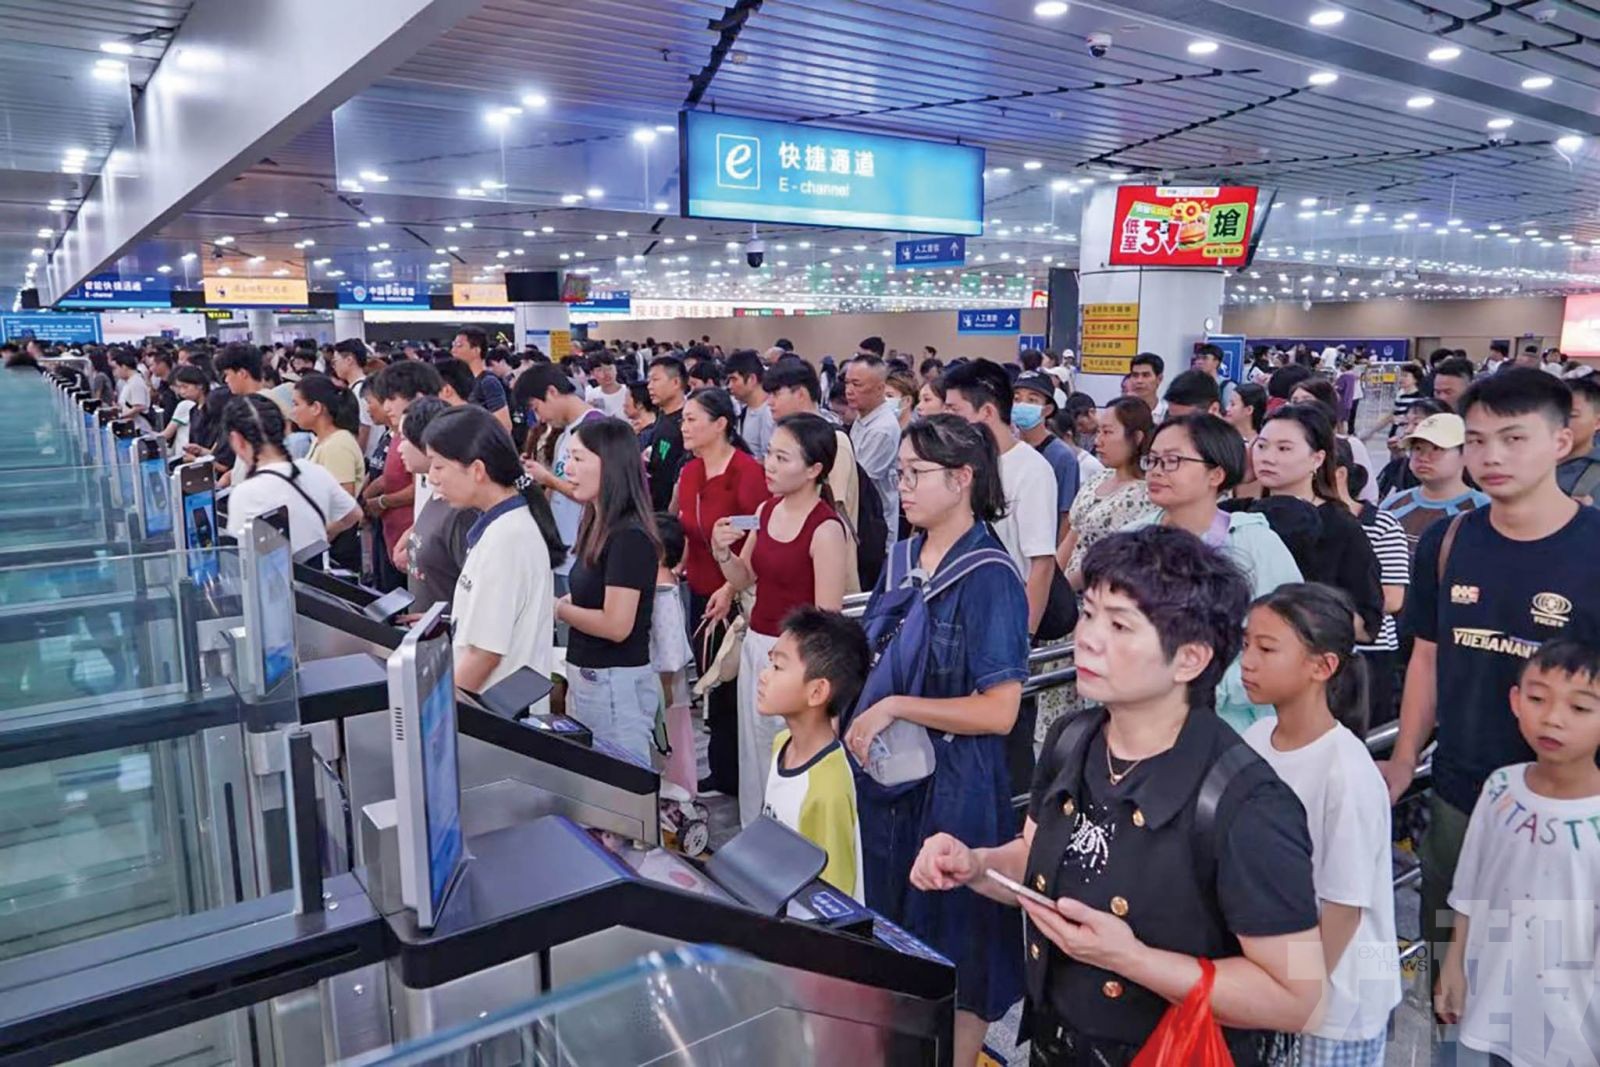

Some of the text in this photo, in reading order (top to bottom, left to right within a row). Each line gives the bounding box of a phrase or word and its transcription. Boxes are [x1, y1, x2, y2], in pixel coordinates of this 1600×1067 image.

[778, 141, 875, 177] 快捷通道
[1124, 218, 1140, 250] 低至
[1213, 208, 1241, 238] 搶
